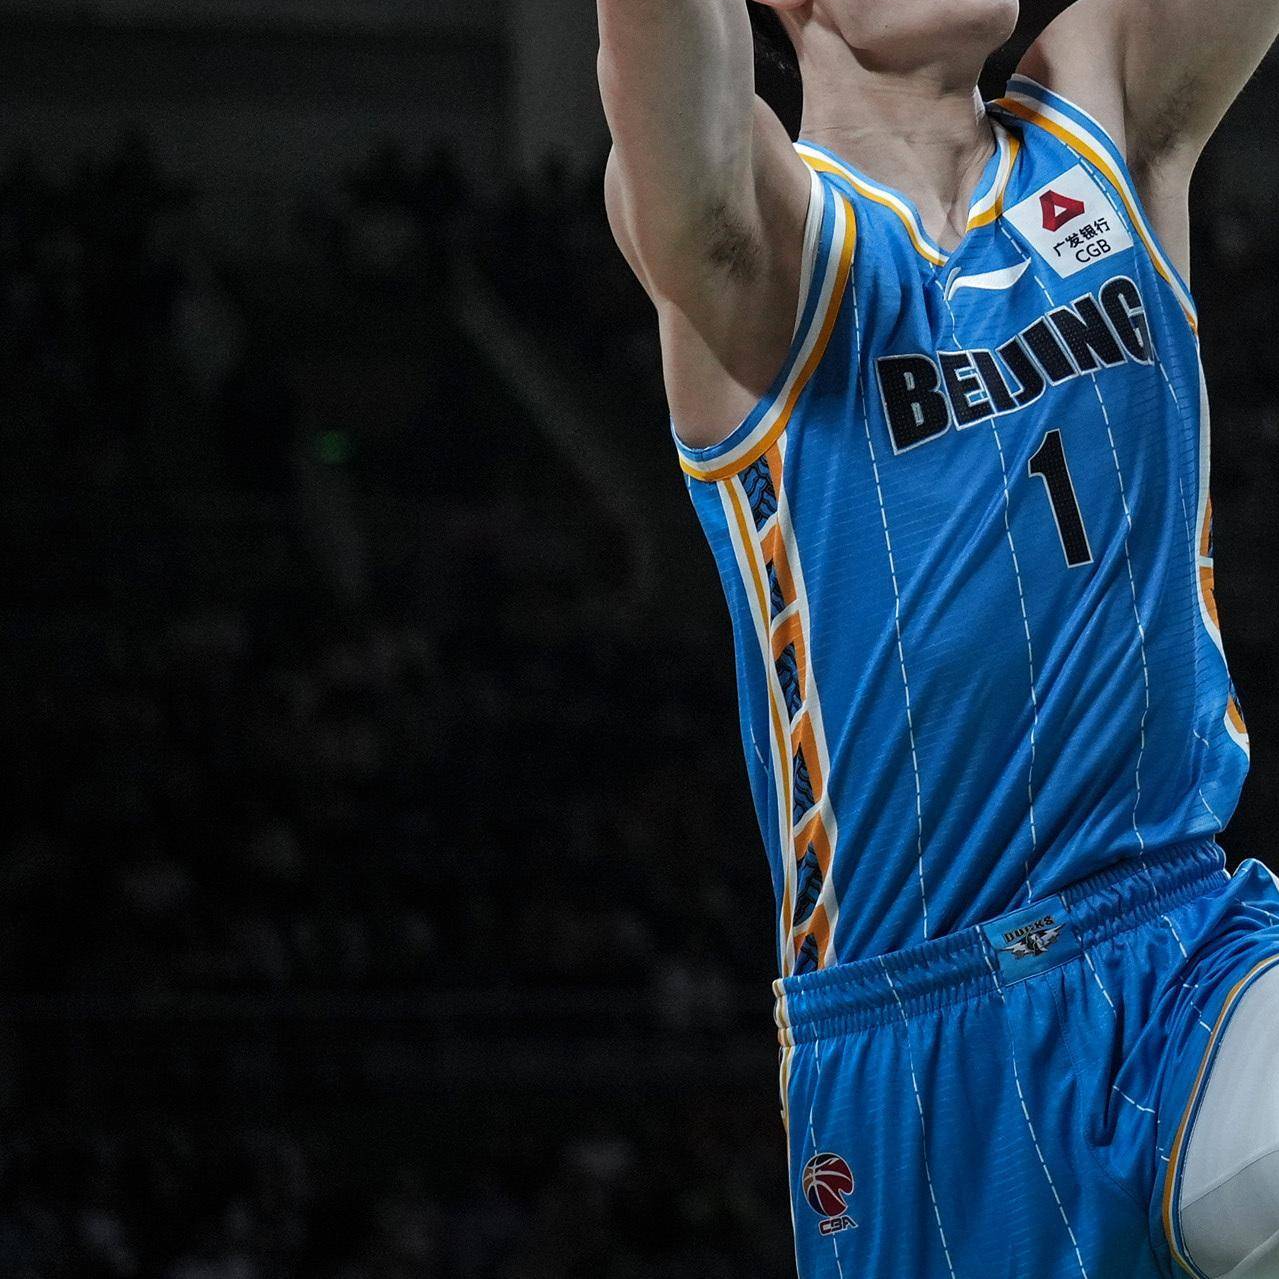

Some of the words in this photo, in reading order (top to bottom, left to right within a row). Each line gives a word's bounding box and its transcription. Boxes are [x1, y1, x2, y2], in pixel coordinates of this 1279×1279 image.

[1052, 217, 1111, 257] 广发银行
[1075, 238, 1111, 263] CGB
[874, 275, 1156, 456] BEIJING
[1028, 428, 1095, 569] 1
[819, 1215, 858, 1236] CBA
